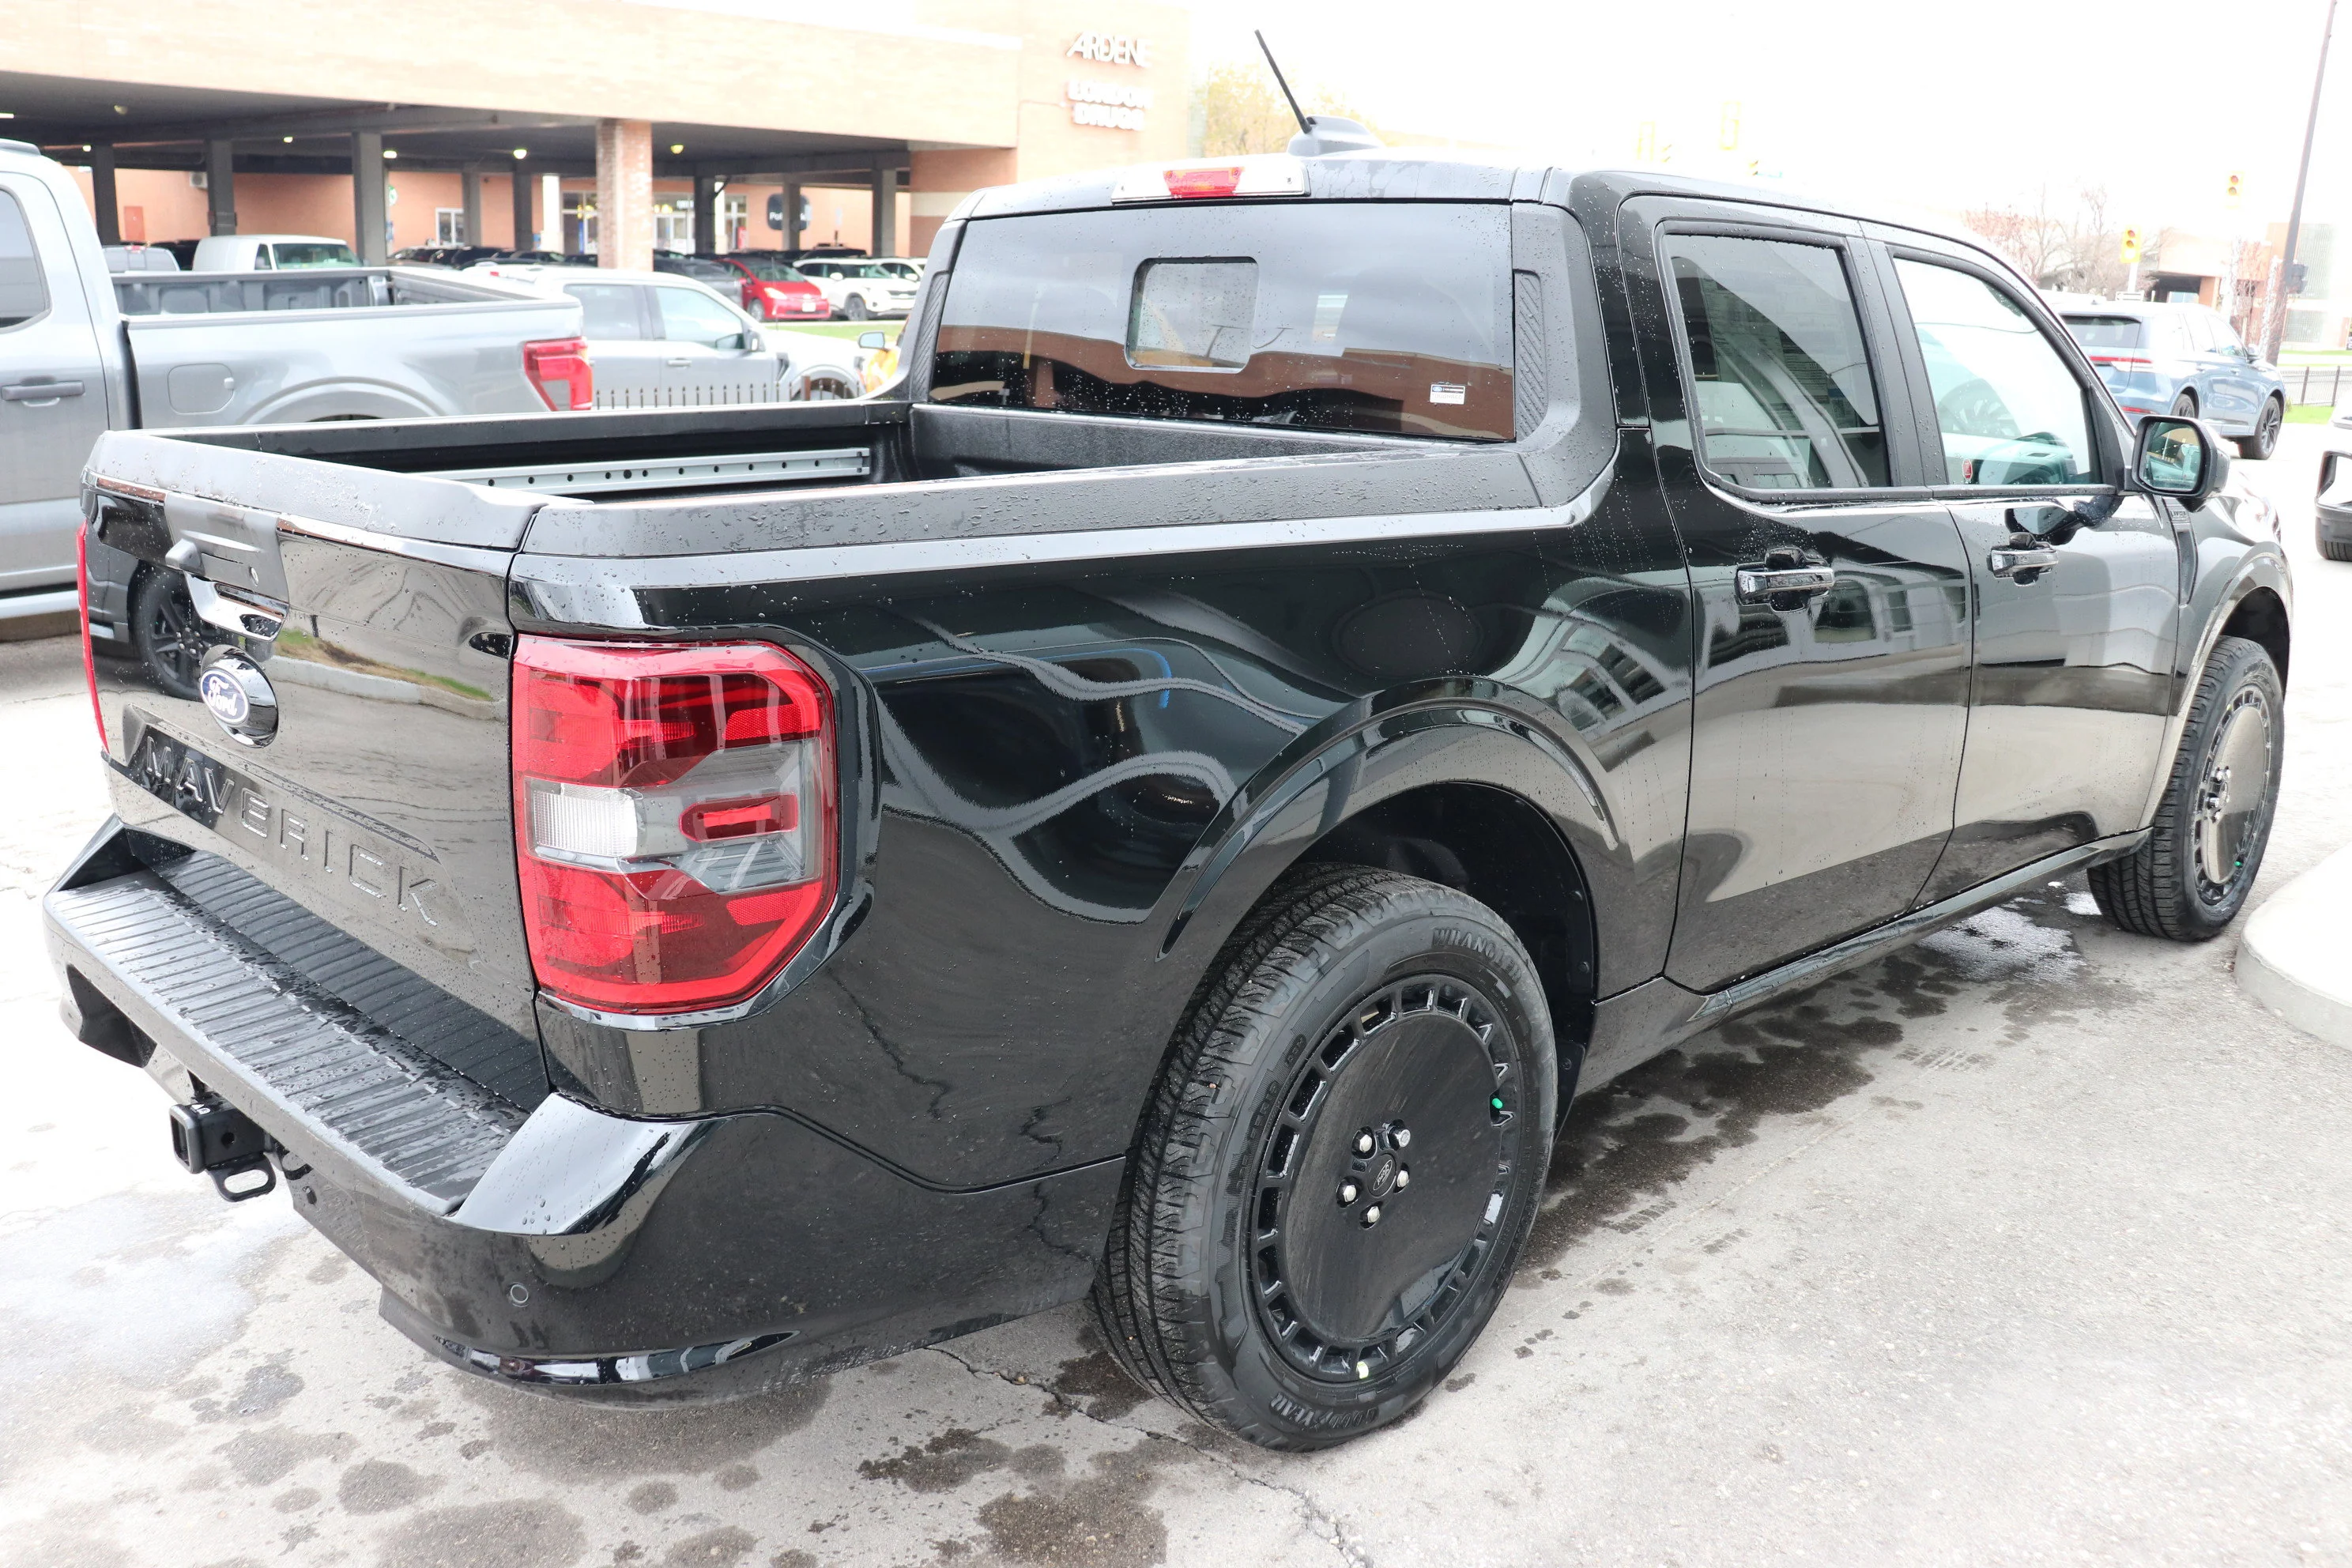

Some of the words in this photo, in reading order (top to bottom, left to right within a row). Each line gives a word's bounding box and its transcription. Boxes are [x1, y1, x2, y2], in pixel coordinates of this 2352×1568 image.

[1065, 31, 1153, 68] ARDENE
[207, 675, 238, 717] Ford
[147, 736, 438, 926] MAVERICK
[1432, 927, 1521, 980] WRANGLER
[1270, 1393, 1378, 1431] GOODYEAR
